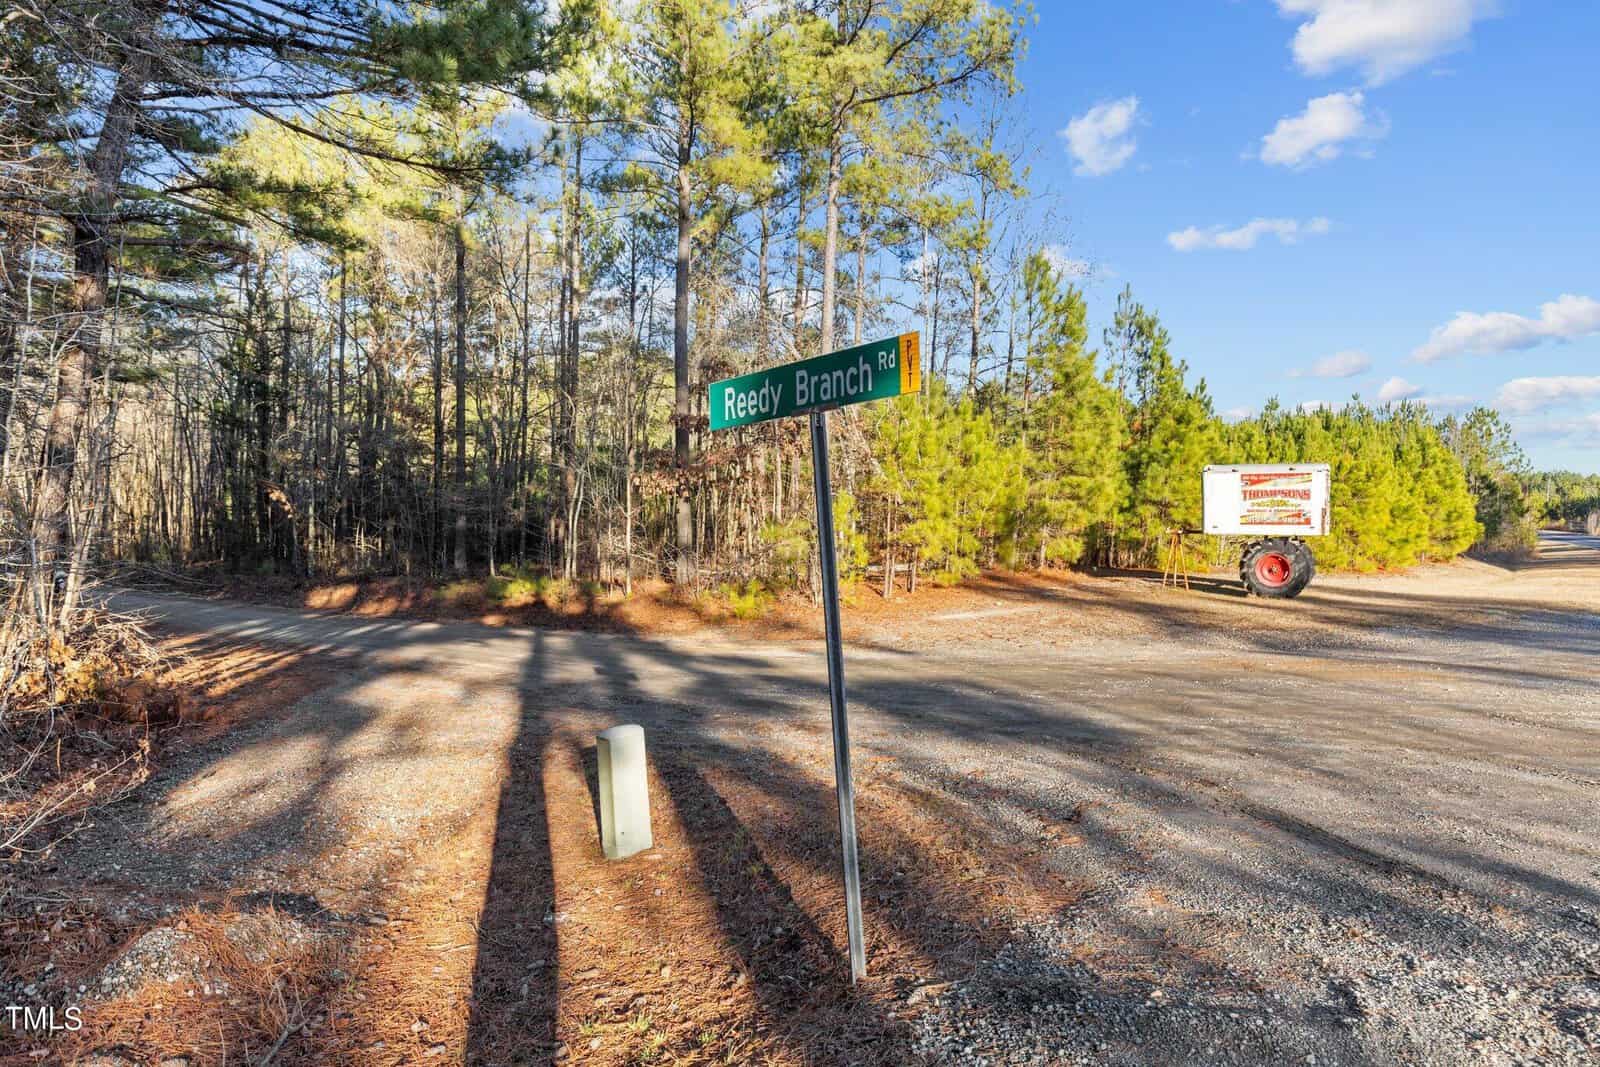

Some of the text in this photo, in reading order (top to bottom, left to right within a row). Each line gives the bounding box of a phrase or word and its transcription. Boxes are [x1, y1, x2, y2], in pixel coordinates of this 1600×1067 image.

[724, 348, 896, 421] Reedy Branch Rd
[905, 339, 913, 388] PVT
